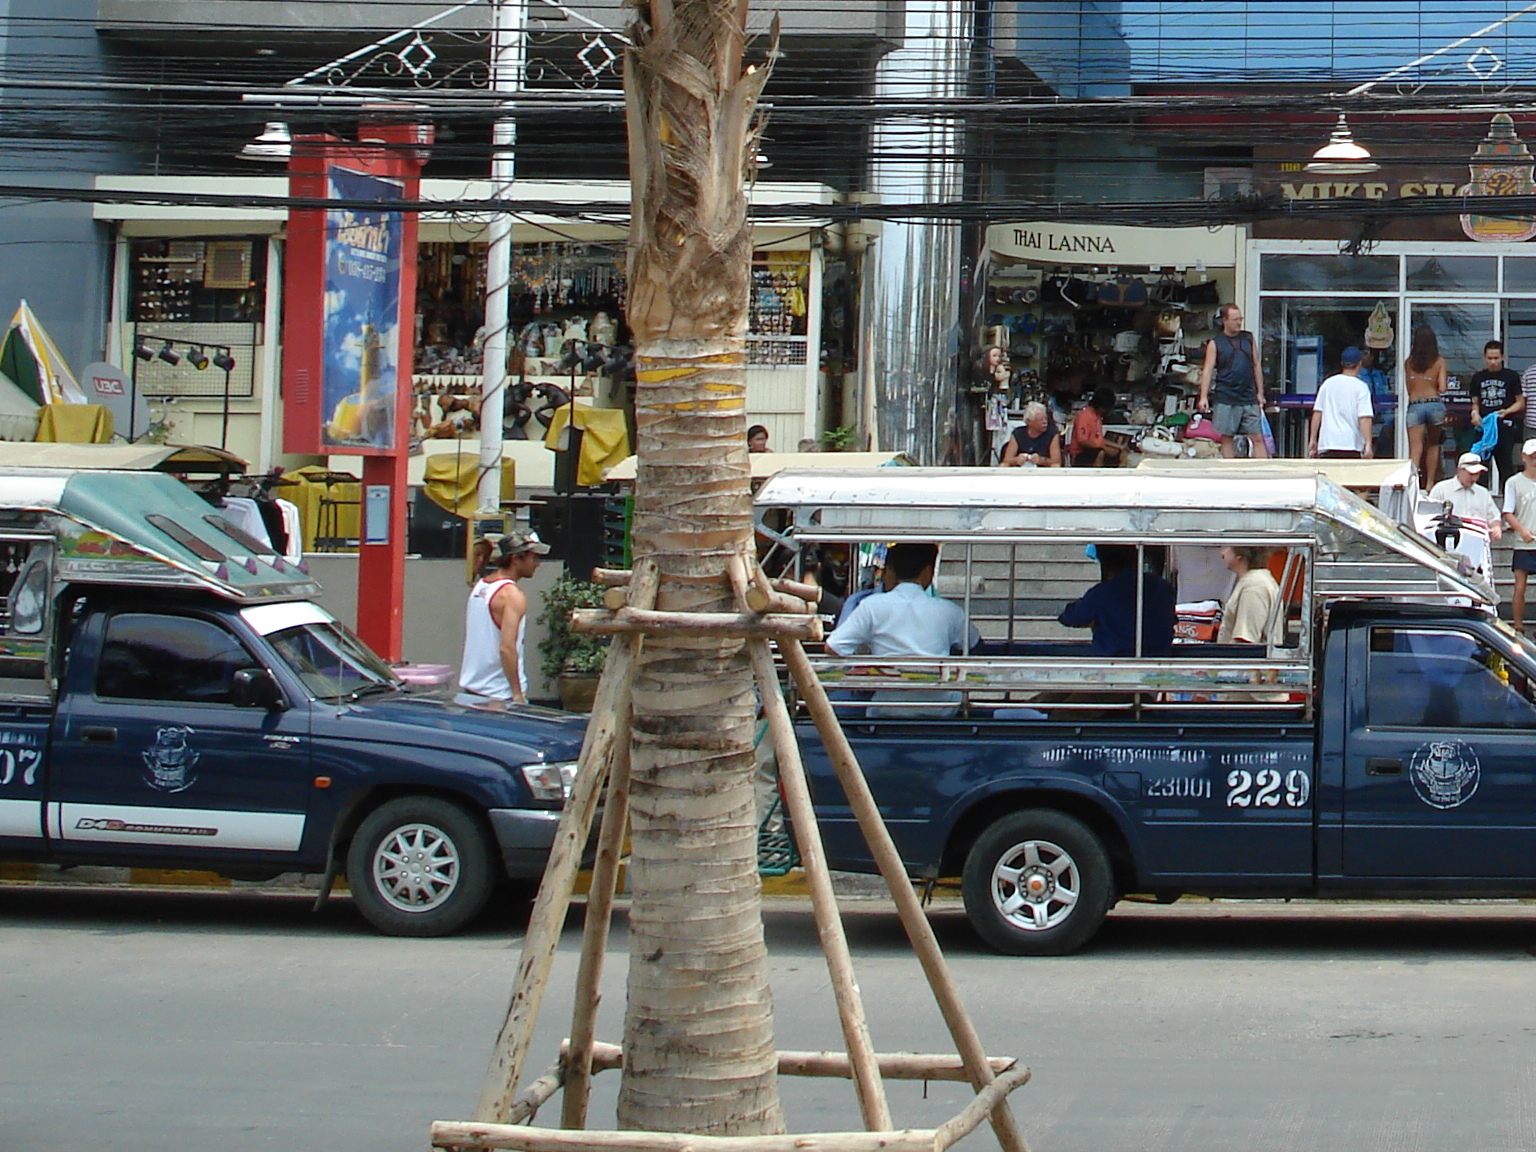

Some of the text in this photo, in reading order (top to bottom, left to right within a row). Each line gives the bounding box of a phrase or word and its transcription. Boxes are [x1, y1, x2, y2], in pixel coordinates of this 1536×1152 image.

[1013, 229, 1116, 253] THAI LANNA
[1226, 768, 1311, 808] 229
